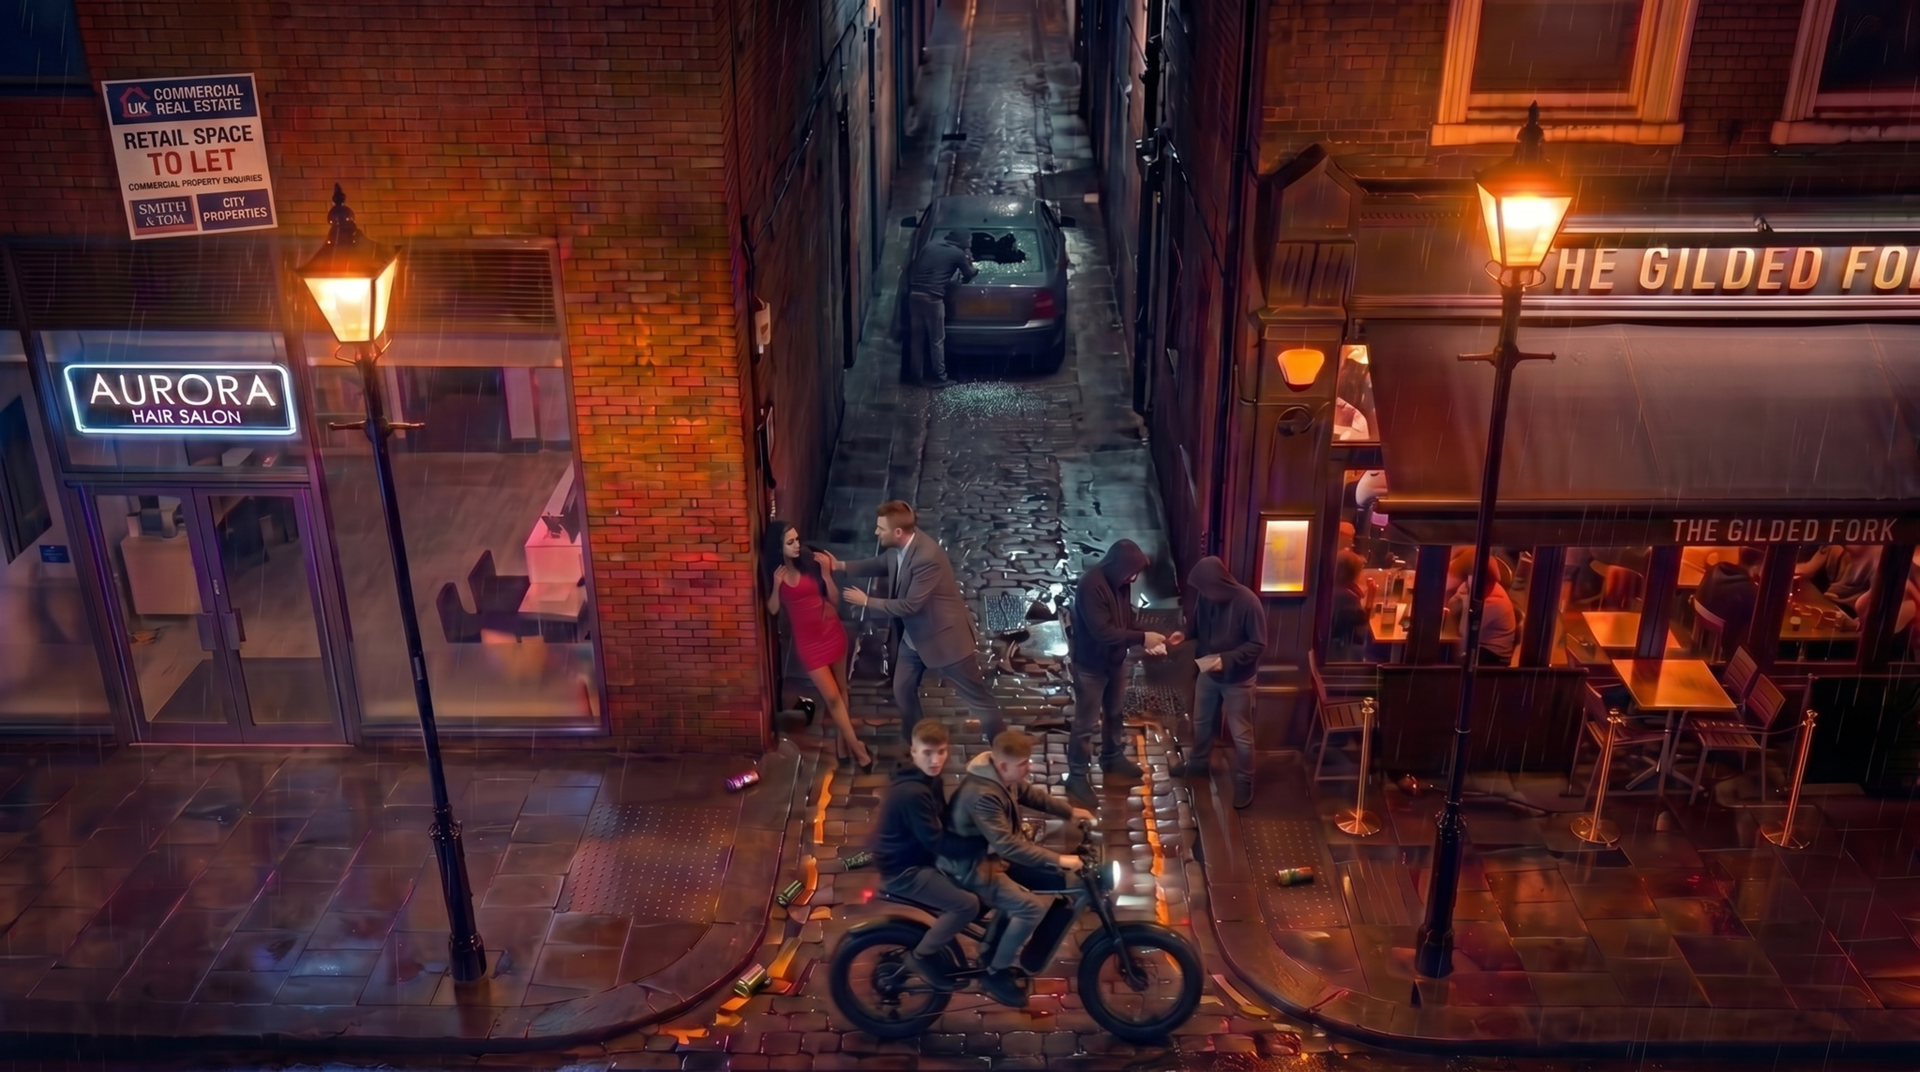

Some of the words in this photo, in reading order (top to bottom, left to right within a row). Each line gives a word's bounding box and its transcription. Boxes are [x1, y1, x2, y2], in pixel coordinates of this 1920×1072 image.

[153, 84, 244, 100] COMMERCIAL
[128, 102, 149, 114] UK
[156, 101, 191, 115] REAL
[194, 98, 242, 112] ESTATE
[123, 129, 189, 149] RETAIL
[193, 125, 254, 145] SPACE
[147, 151, 182, 176] TO
[190, 148, 235, 173] LET
[128, 181, 180, 191] COMMERCIAL
[182, 177, 221, 187] PROPERTY
[223, 174, 263, 184] ENQUIRIES
[139, 201, 187, 215] SMITH
[223, 197, 245, 208] CITY
[145, 216, 155, 226] &
[156, 214, 185, 225] TOM
[203, 207, 268, 222] PROPERTIES
[1549, 248, 1618, 290] HE
[1639, 247, 1823, 290] GILDED
[90, 373, 276, 406] AURORA
[132, 409, 174, 423] HAIR
[179, 409, 241, 424] SALON
[1673, 519, 1719, 542] THE
[1727, 519, 1819, 542] GILDED
[1828, 518, 1898, 543] FORK
